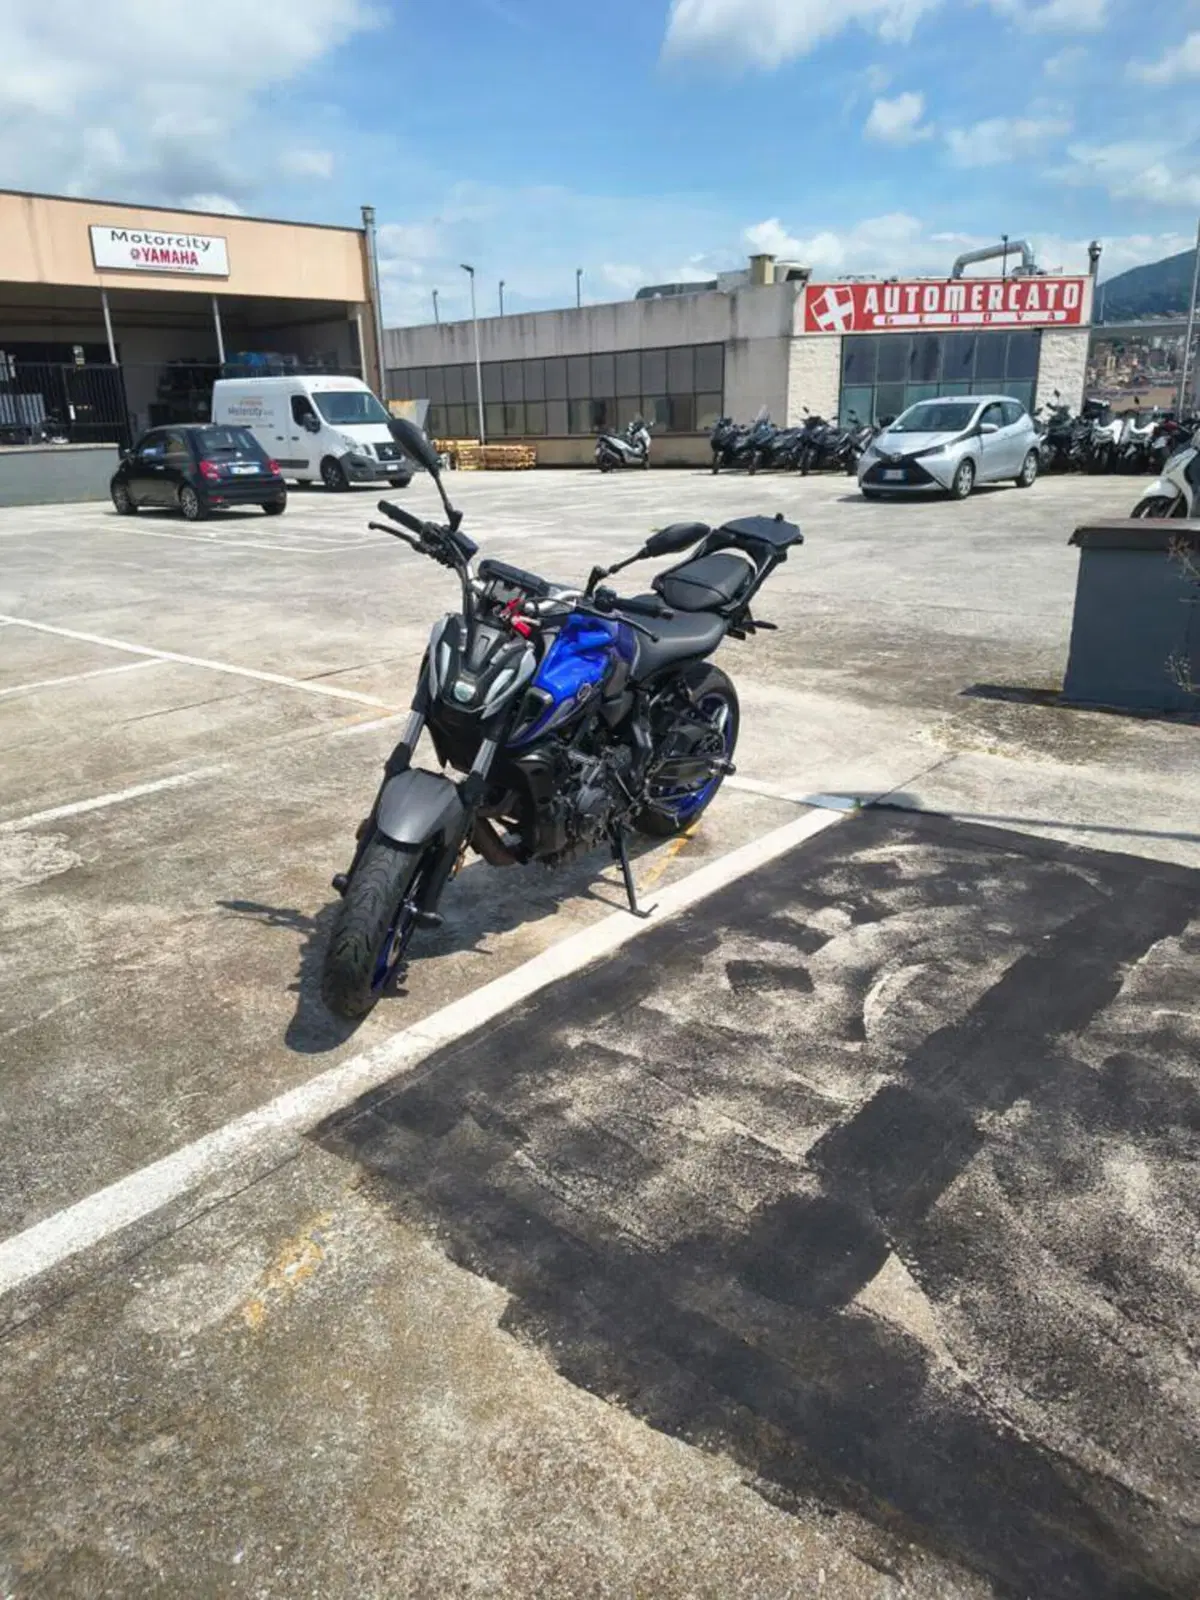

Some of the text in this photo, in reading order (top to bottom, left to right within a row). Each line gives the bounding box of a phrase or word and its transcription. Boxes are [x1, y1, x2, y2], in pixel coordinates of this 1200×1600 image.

[111, 230, 211, 252] Motorcity
[141, 248, 199, 265] YAMAHA
[863, 283, 1080, 314] AUTOMERCATO
[884, 311, 1056, 325] GENOVA
